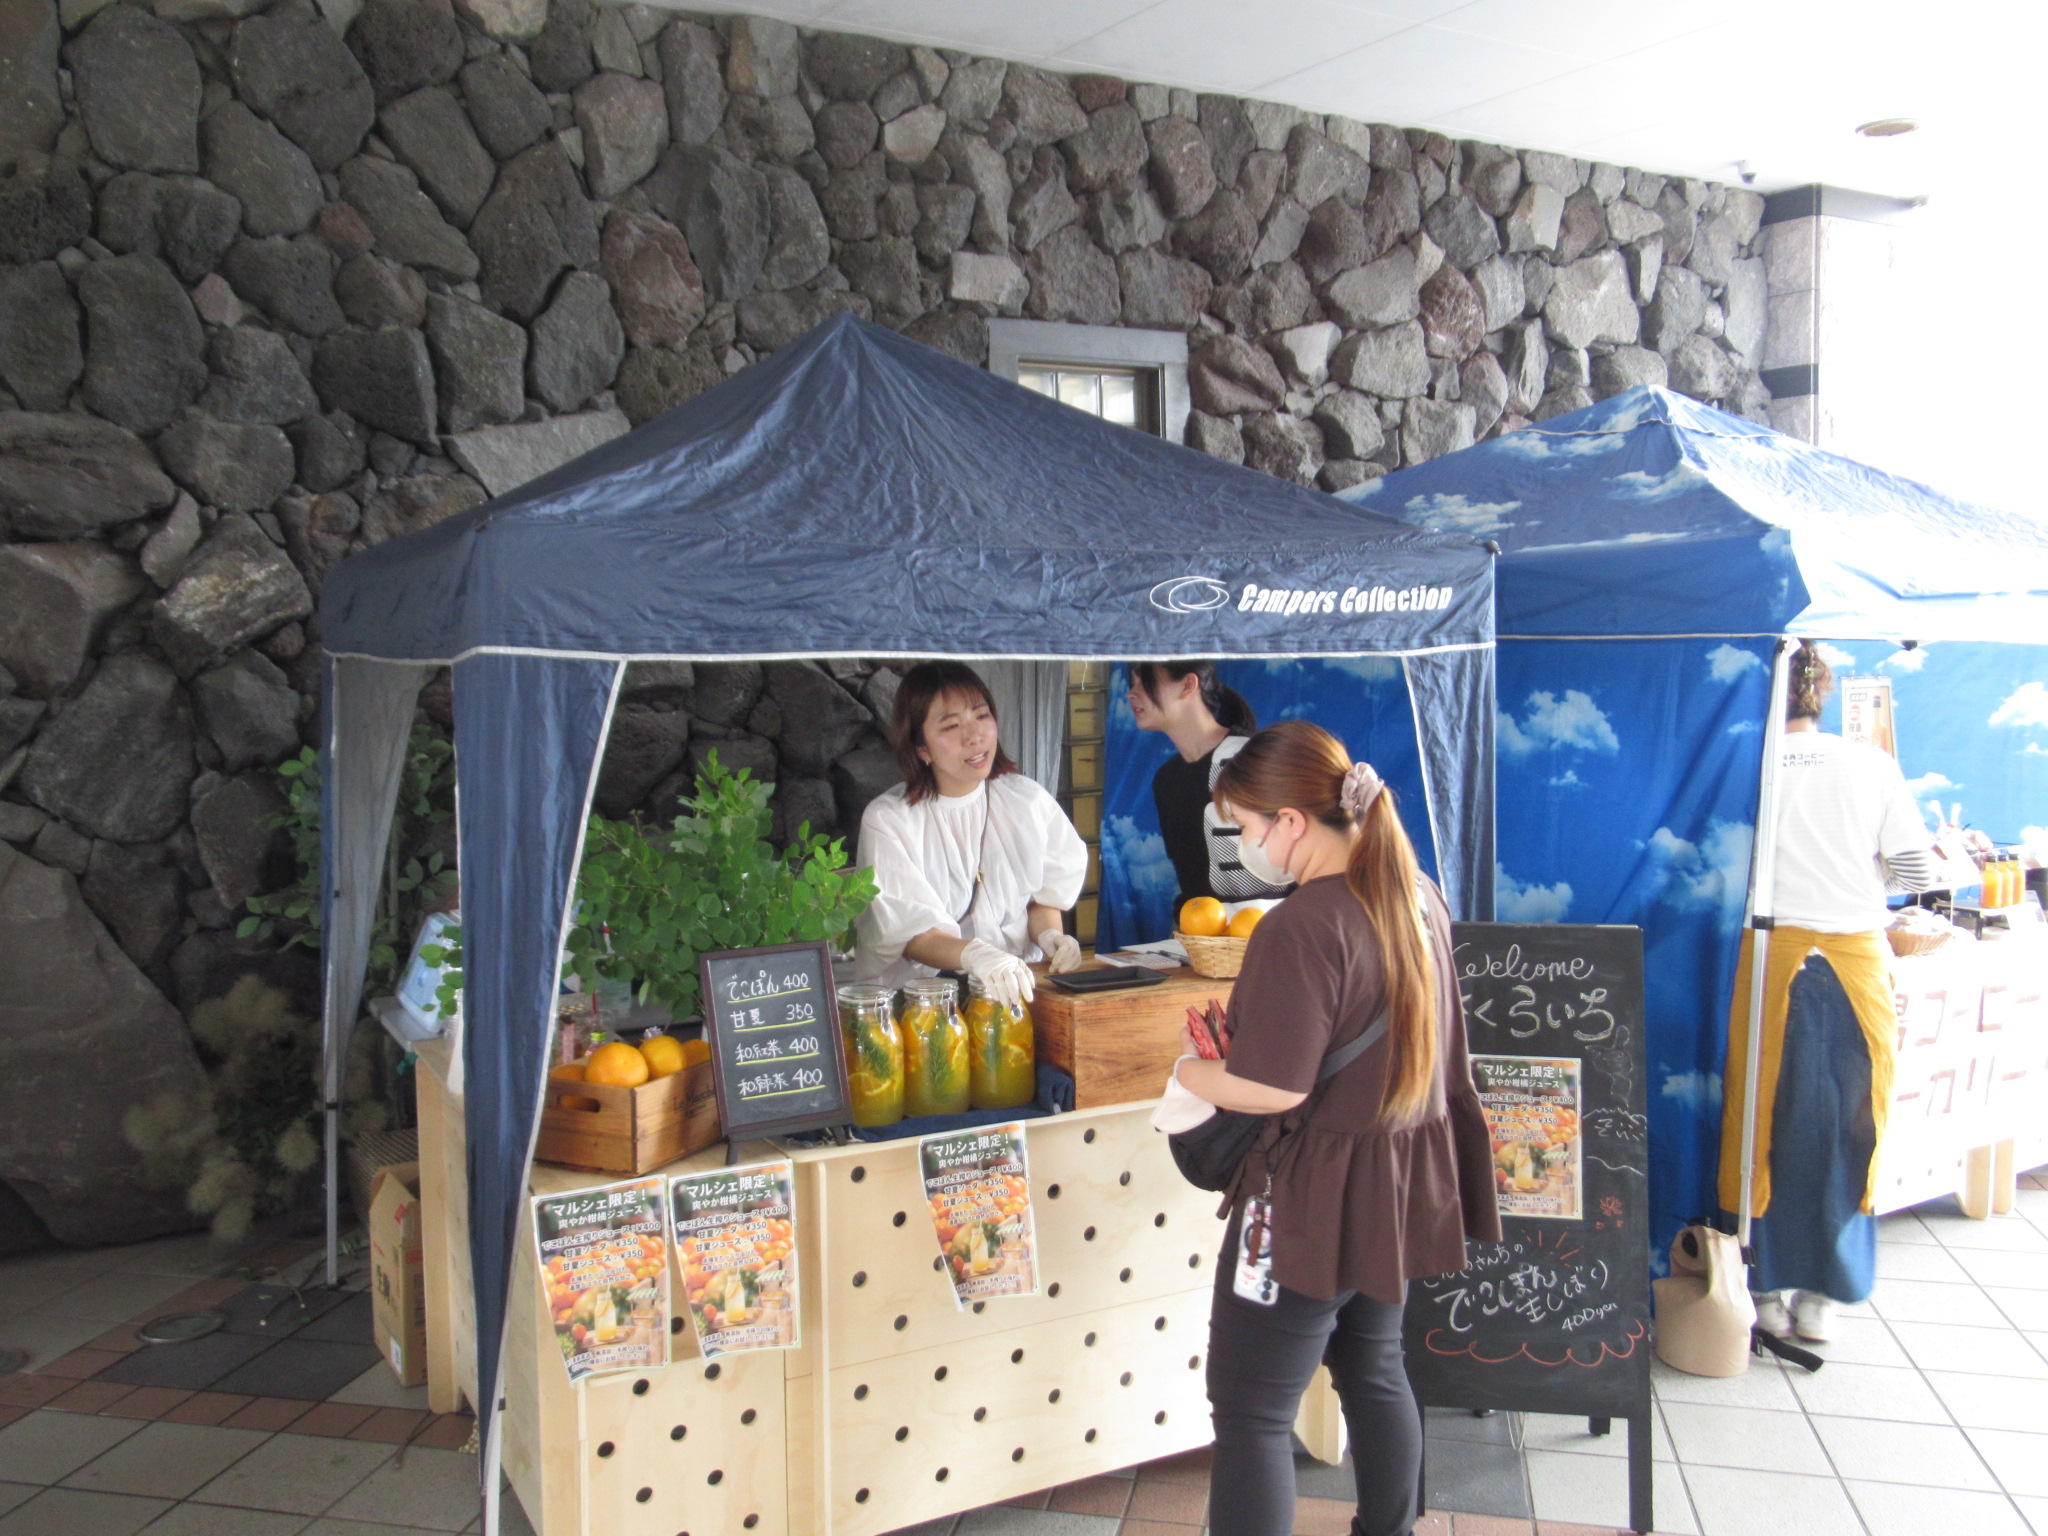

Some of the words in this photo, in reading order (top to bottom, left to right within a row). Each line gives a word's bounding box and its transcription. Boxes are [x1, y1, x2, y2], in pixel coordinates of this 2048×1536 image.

[1238, 583, 1338, 616] Campers
[1340, 585, 1453, 613] Collection
[726, 970, 779, 1001] でこぽん
[783, 973, 809, 988] 400
[786, 1003, 814, 1021] 350
[735, 1039, 783, 1063] 和紅茶
[789, 1036, 819, 1054] 400
[792, 1068, 823, 1088] 400
[686, 1173, 775, 1198] マルシェ限定！
[552, 1189, 646, 1217] マルシェ限定！
[1434, 1261, 1558, 1332] でこぽん
